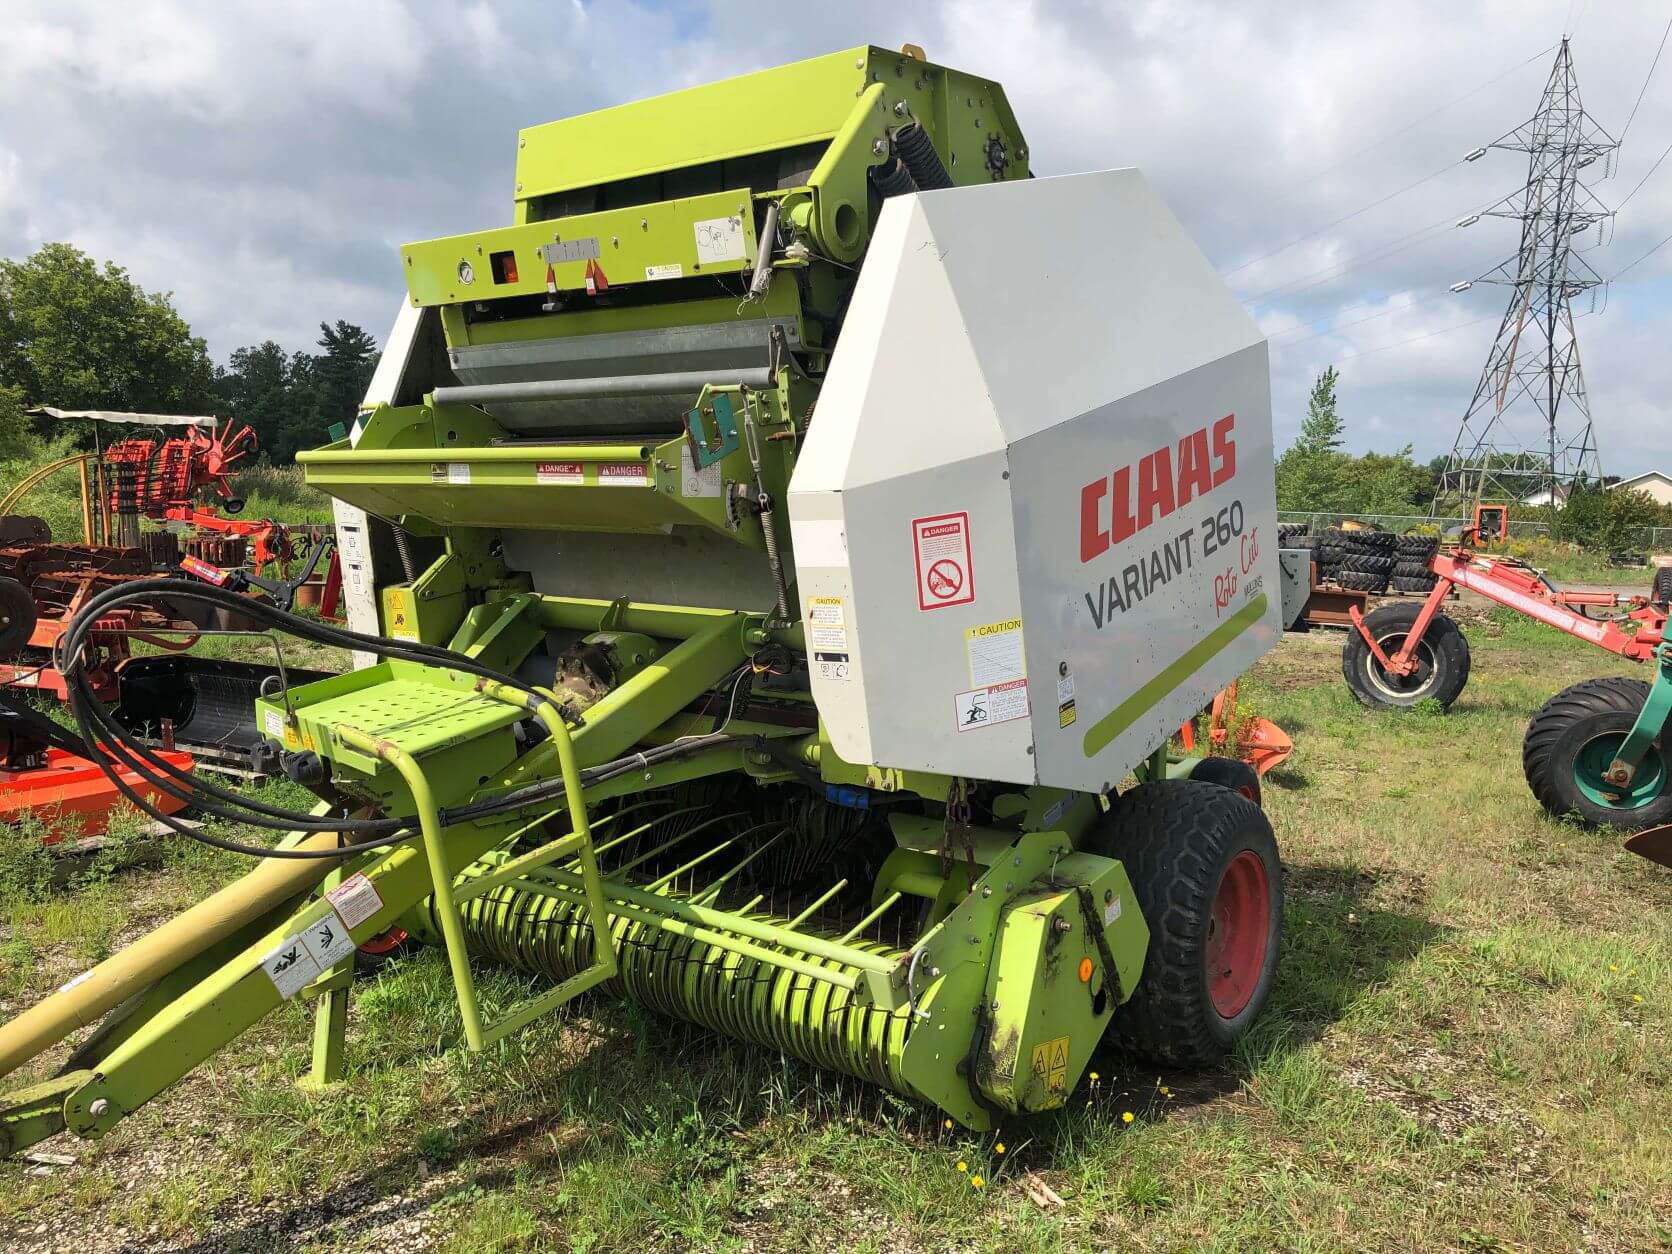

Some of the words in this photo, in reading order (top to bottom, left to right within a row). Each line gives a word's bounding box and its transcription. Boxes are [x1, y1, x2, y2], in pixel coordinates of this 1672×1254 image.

[610, 466, 643, 476] DANGER
[1080, 413, 1236, 564] CLAAS
[930, 525, 959, 535] DANGER
[1084, 527, 1194, 630] VARIANT
[1201, 500, 1244, 557] 260
[1214, 566, 1237, 618] Roto
[1240, 527, 1259, 575] Cut
[979, 619, 1021, 636] CAUTION
[999, 680, 1025, 693] DANGER
